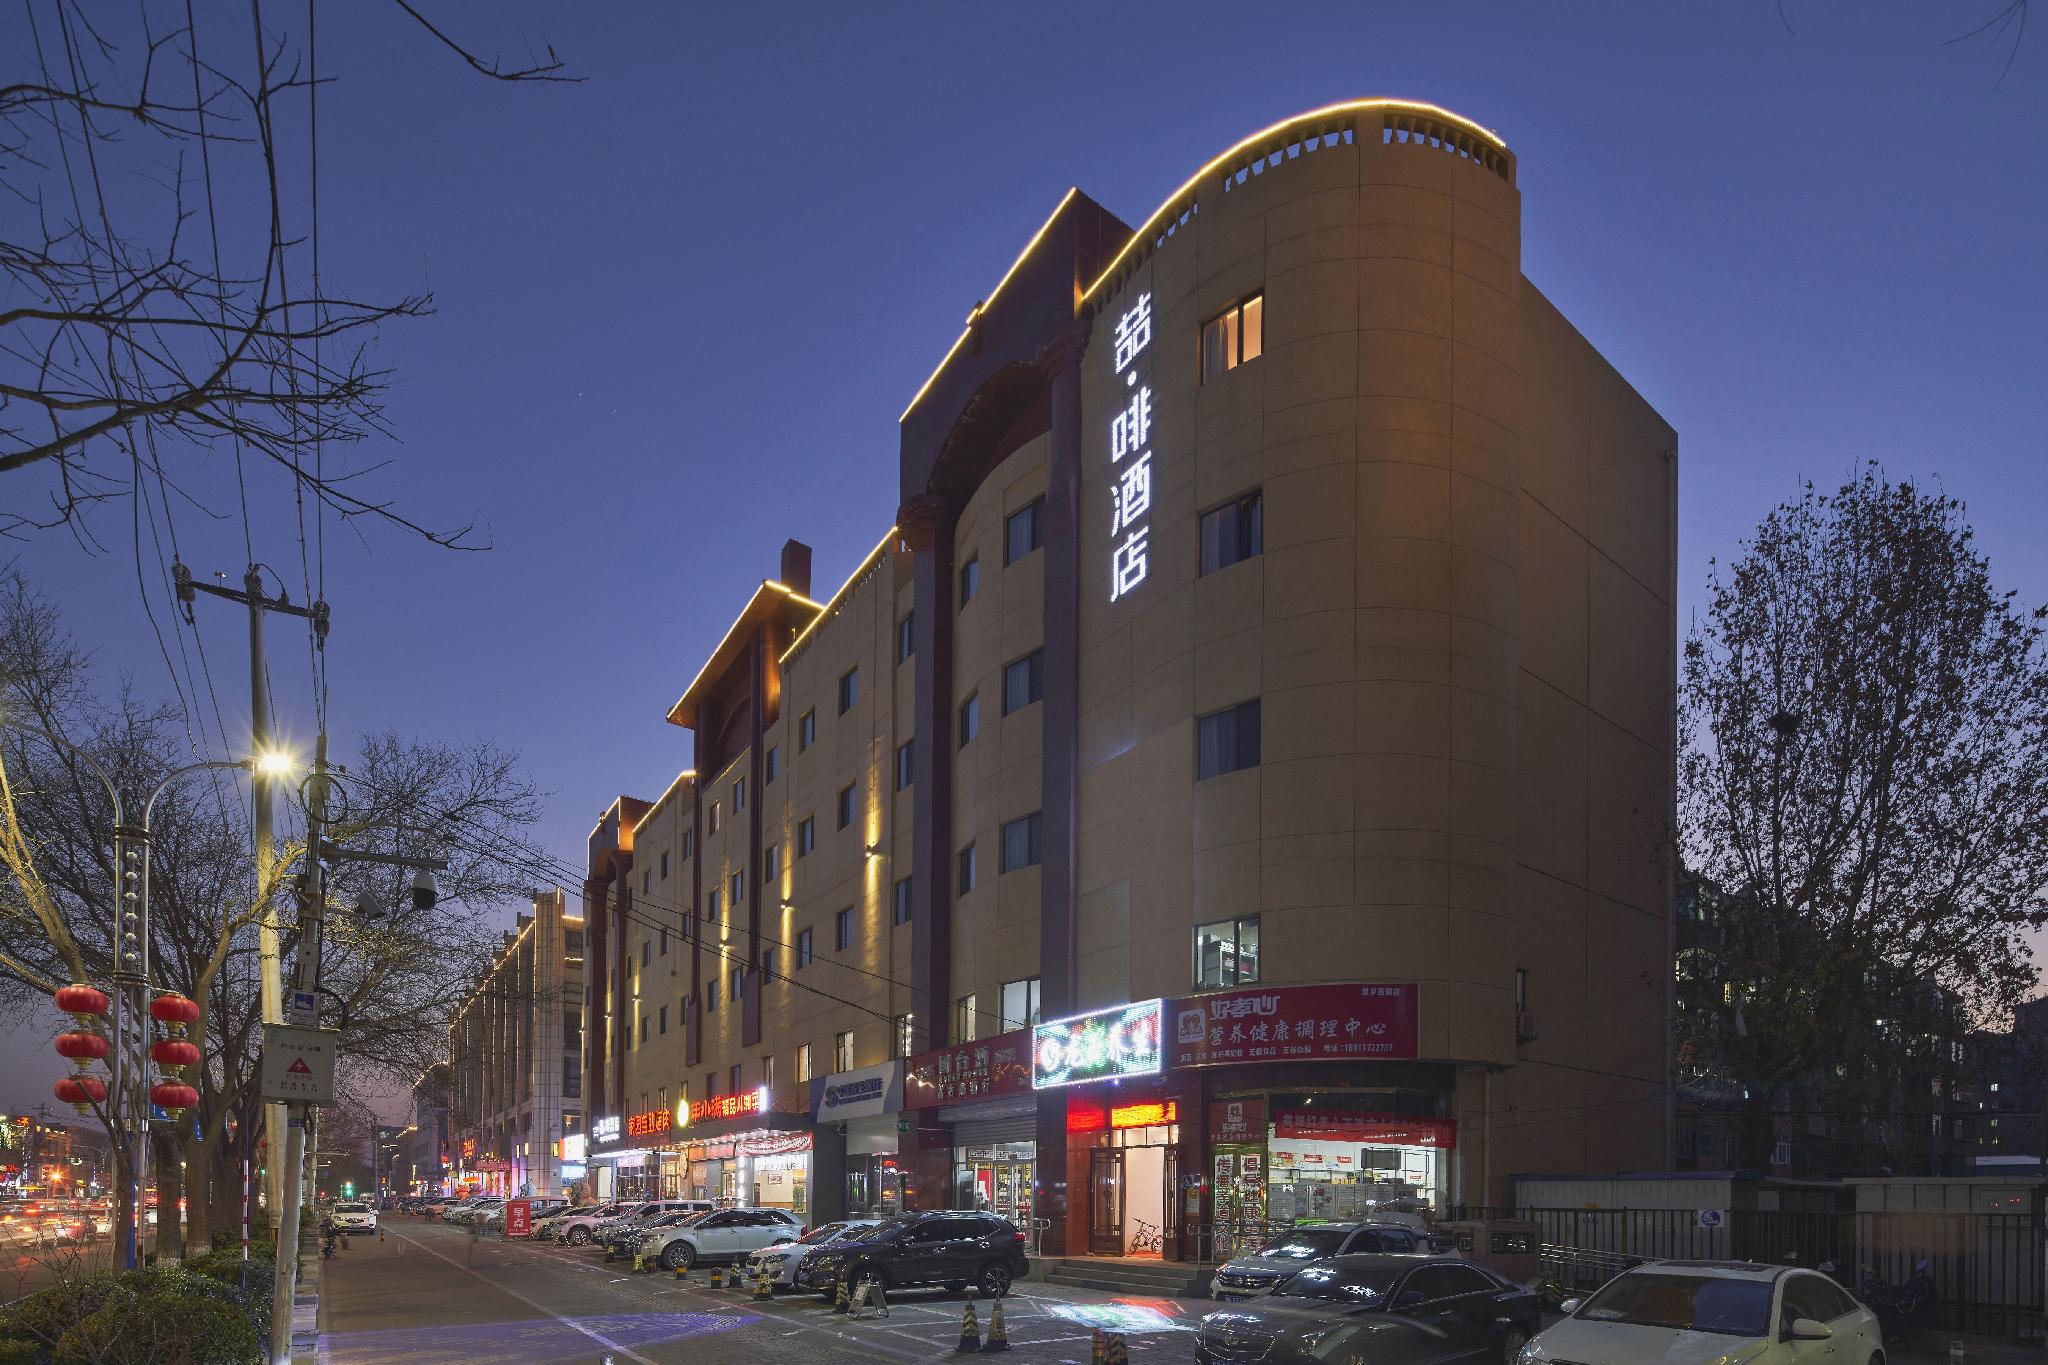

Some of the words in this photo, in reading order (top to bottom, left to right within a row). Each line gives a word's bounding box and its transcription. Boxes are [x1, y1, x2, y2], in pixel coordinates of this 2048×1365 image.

[1209, 1018, 1387, 1046] 营养健康调理中心
[513, 1207, 525, 1227] 早点
[1216, 1158, 1231, 1251] 传播孝道文化
